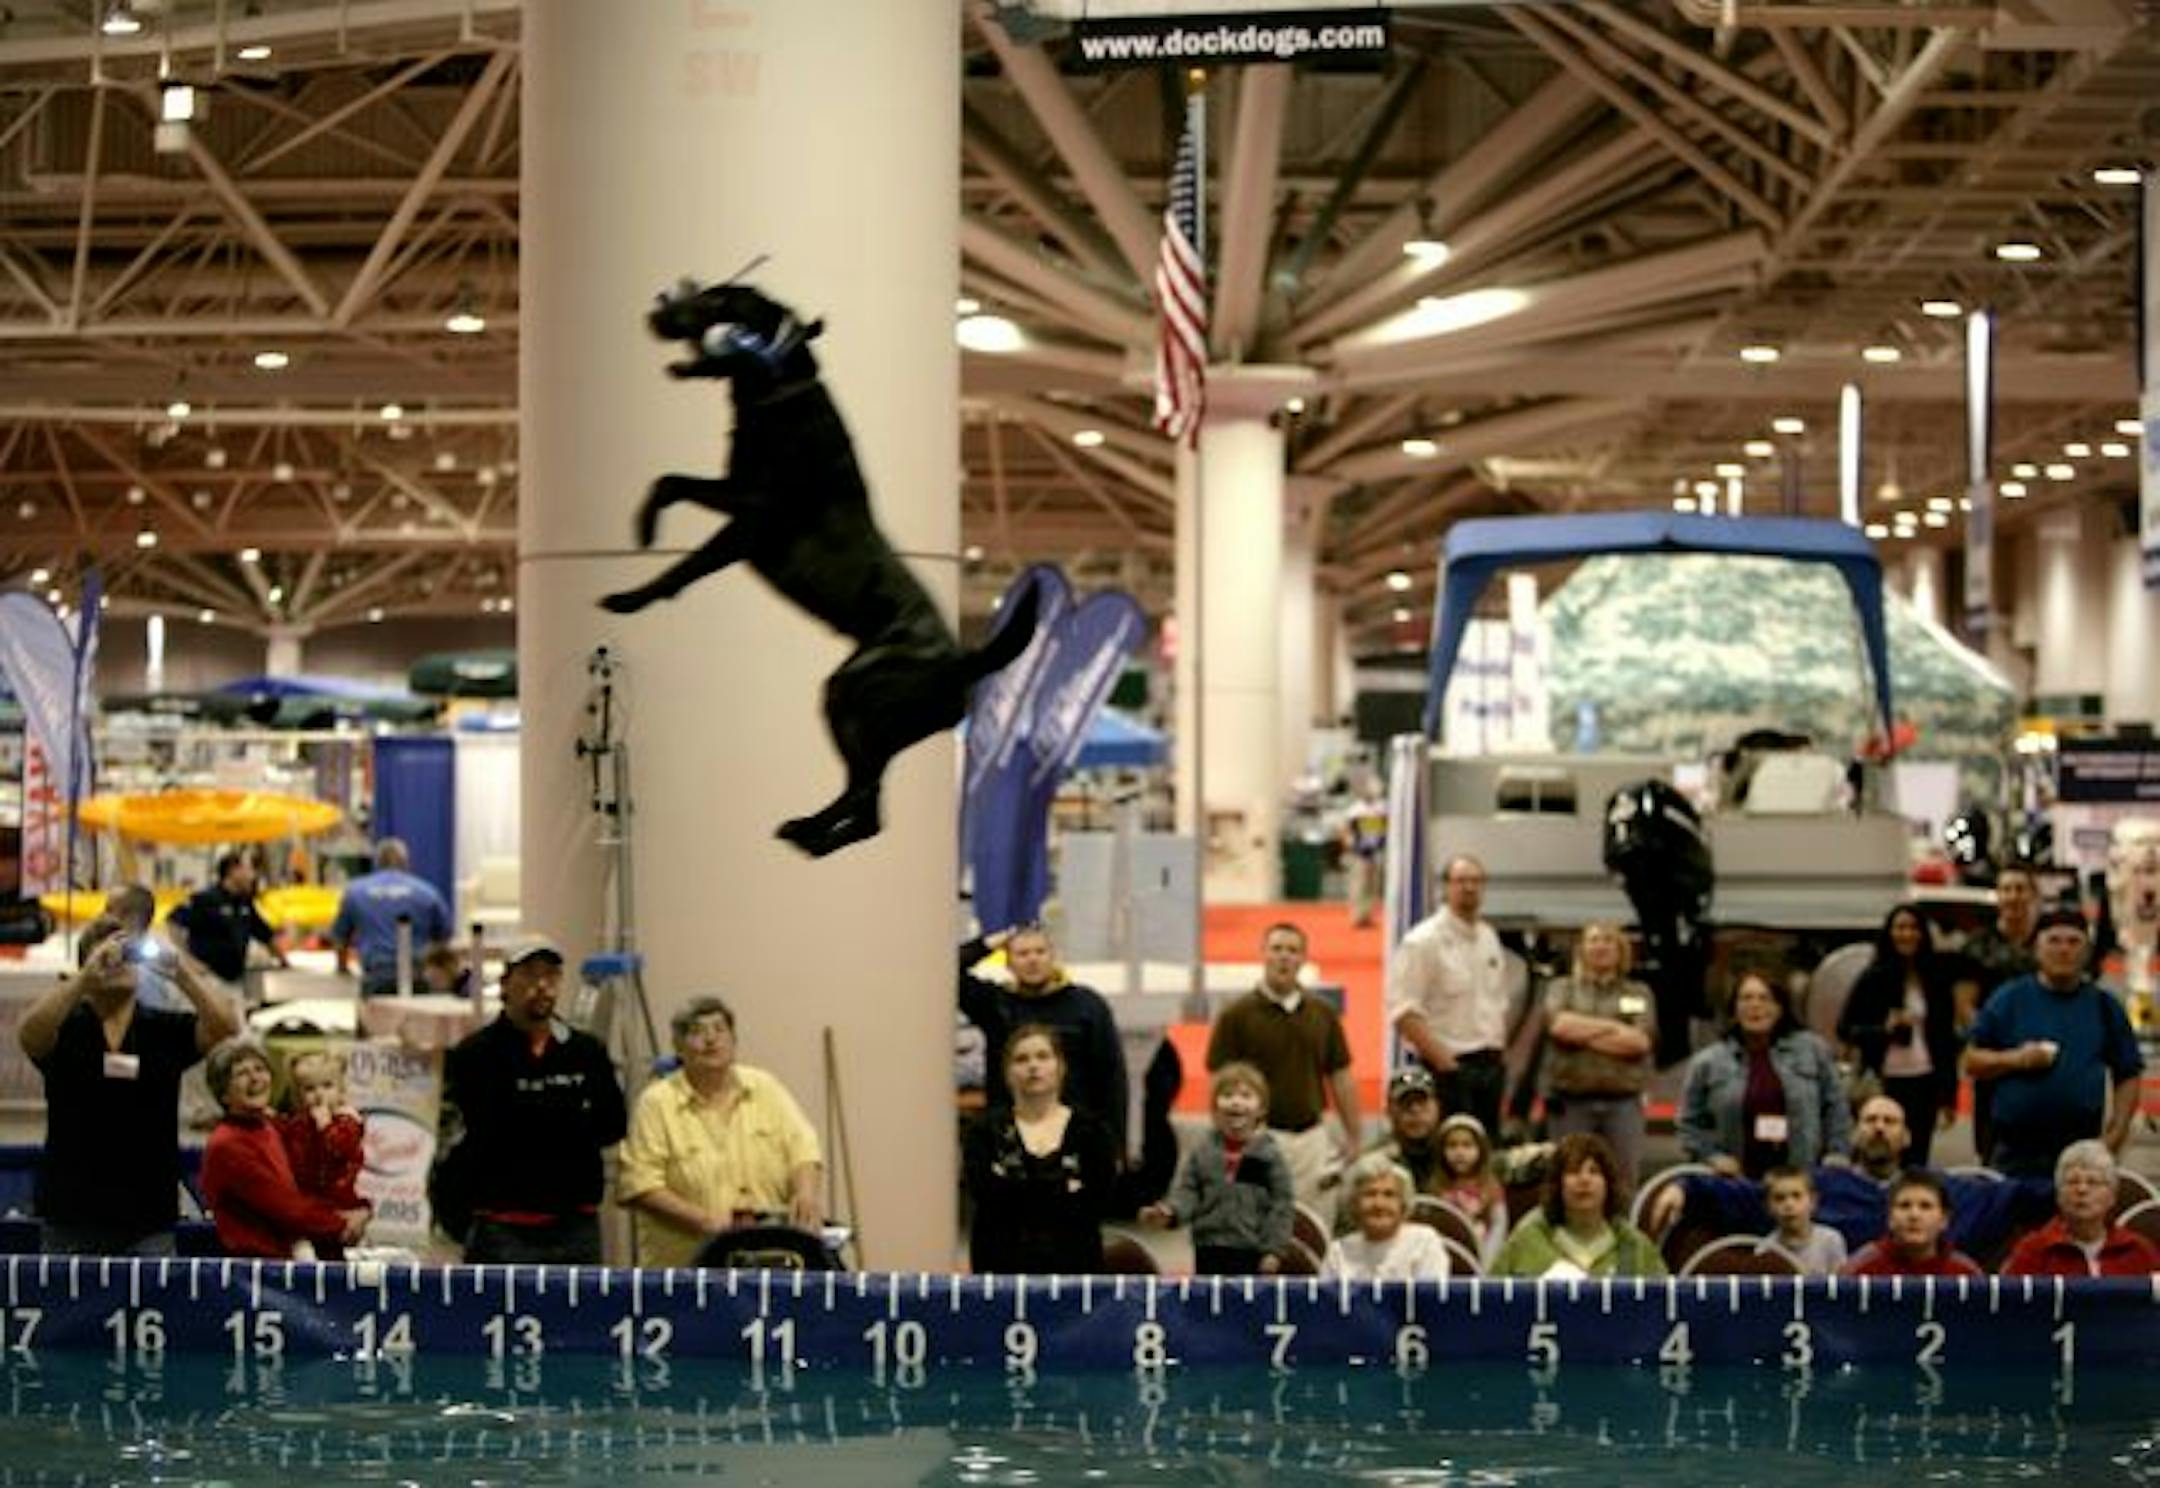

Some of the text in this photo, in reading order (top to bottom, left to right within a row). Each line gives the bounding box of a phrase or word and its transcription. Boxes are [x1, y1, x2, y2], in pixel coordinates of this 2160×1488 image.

[1080, 24, 1386, 60] www.dockdogs.com
[684, 50, 762, 97] SW
[105, 1310, 165, 1351] 16
[224, 1311, 283, 1354] 15
[353, 1313, 415, 1352] 14
[482, 1314, 543, 1355] 13
[611, 1317, 673, 1357] 12
[741, 1317, 796, 1361] 11
[863, 1320, 927, 1365] 10
[1004, 1321, 1037, 1366] 9
[1133, 1323, 1166, 1367] 8
[1264, 1324, 1297, 1364] 7
[1395, 1325, 1428, 1364] 6
[1527, 1324, 1560, 1363] 5
[1659, 1321, 1693, 1364] 4
[1782, 1321, 1814, 1365] 3
[1915, 1321, 1946, 1363] 2
[2051, 1321, 2075, 1363] 1
